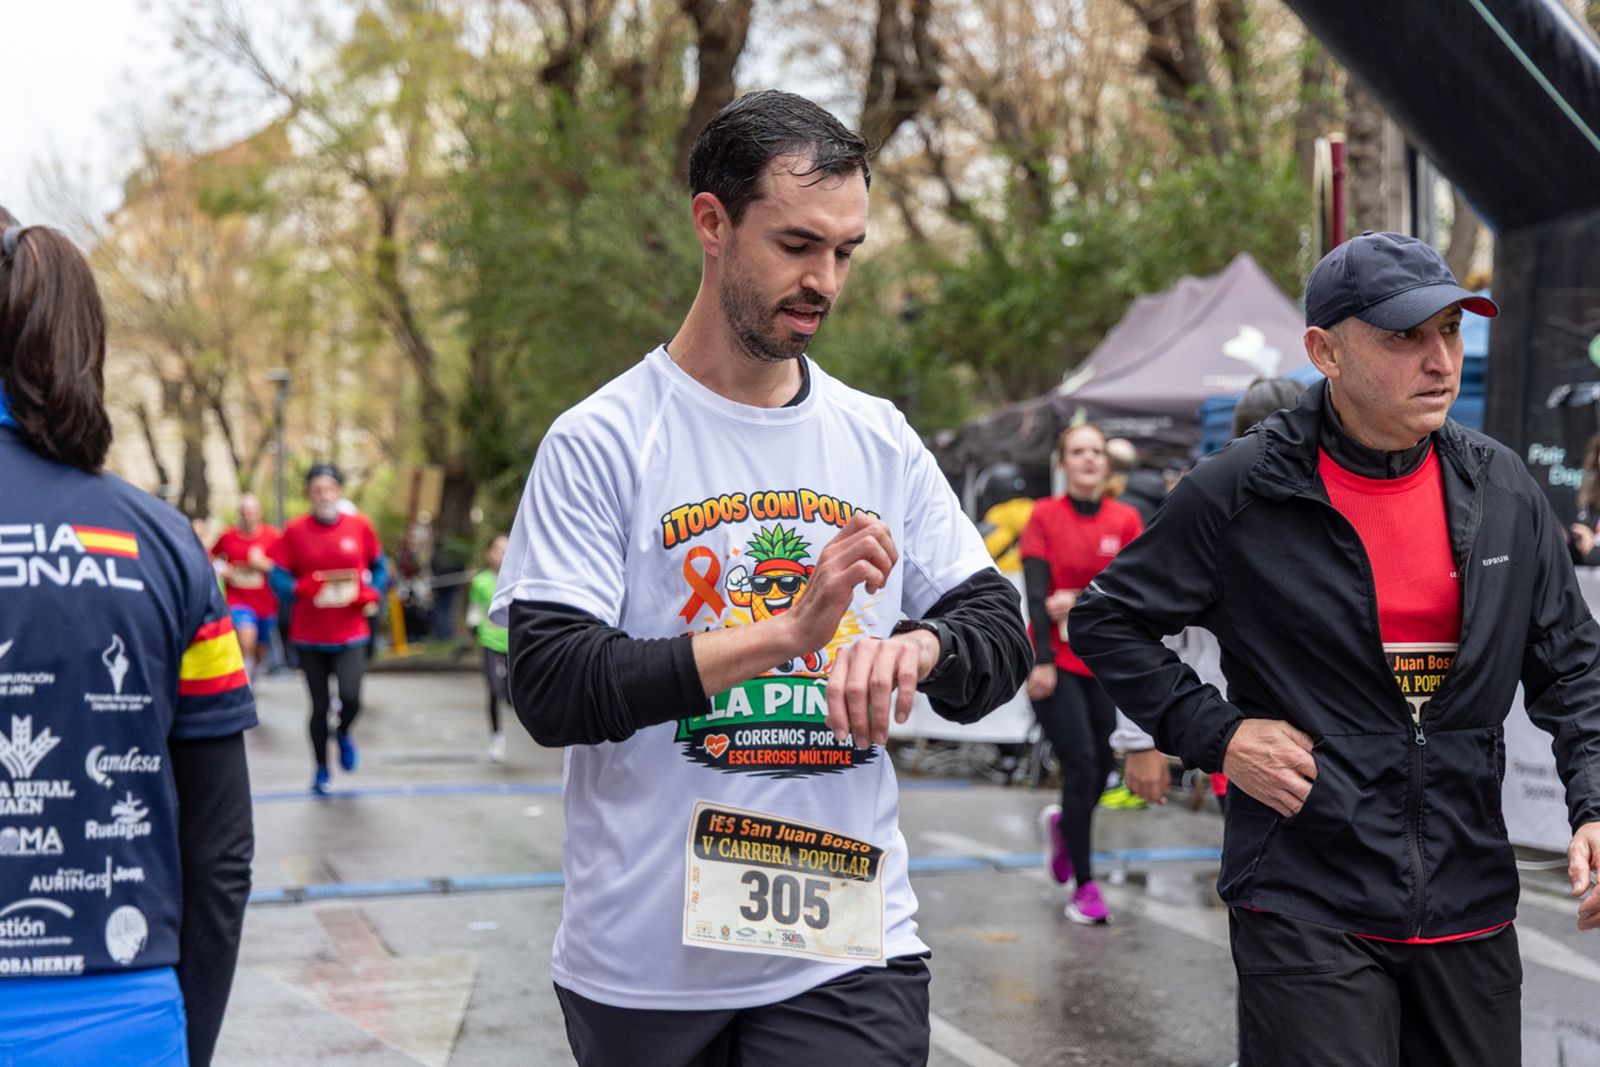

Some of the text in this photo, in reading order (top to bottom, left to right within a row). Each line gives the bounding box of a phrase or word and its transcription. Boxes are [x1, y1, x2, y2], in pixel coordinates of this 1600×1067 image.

[750, 489, 799, 520] CON
[1393, 655, 1425, 672] Juan
[705, 686, 754, 721] LA
[735, 728, 806, 746] CORREMOS
[810, 730, 835, 746] POR
[85, 745, 162, 787] Candesa
[728, 747, 852, 765] ESCLEROSIS MÚLTIPLE
[13, 780, 76, 799] RURAL
[709, 814, 872, 854] IES San Juan Bosco
[702, 835, 871, 877] V CARRERA POPULAR
[739, 870, 831, 930] 305
